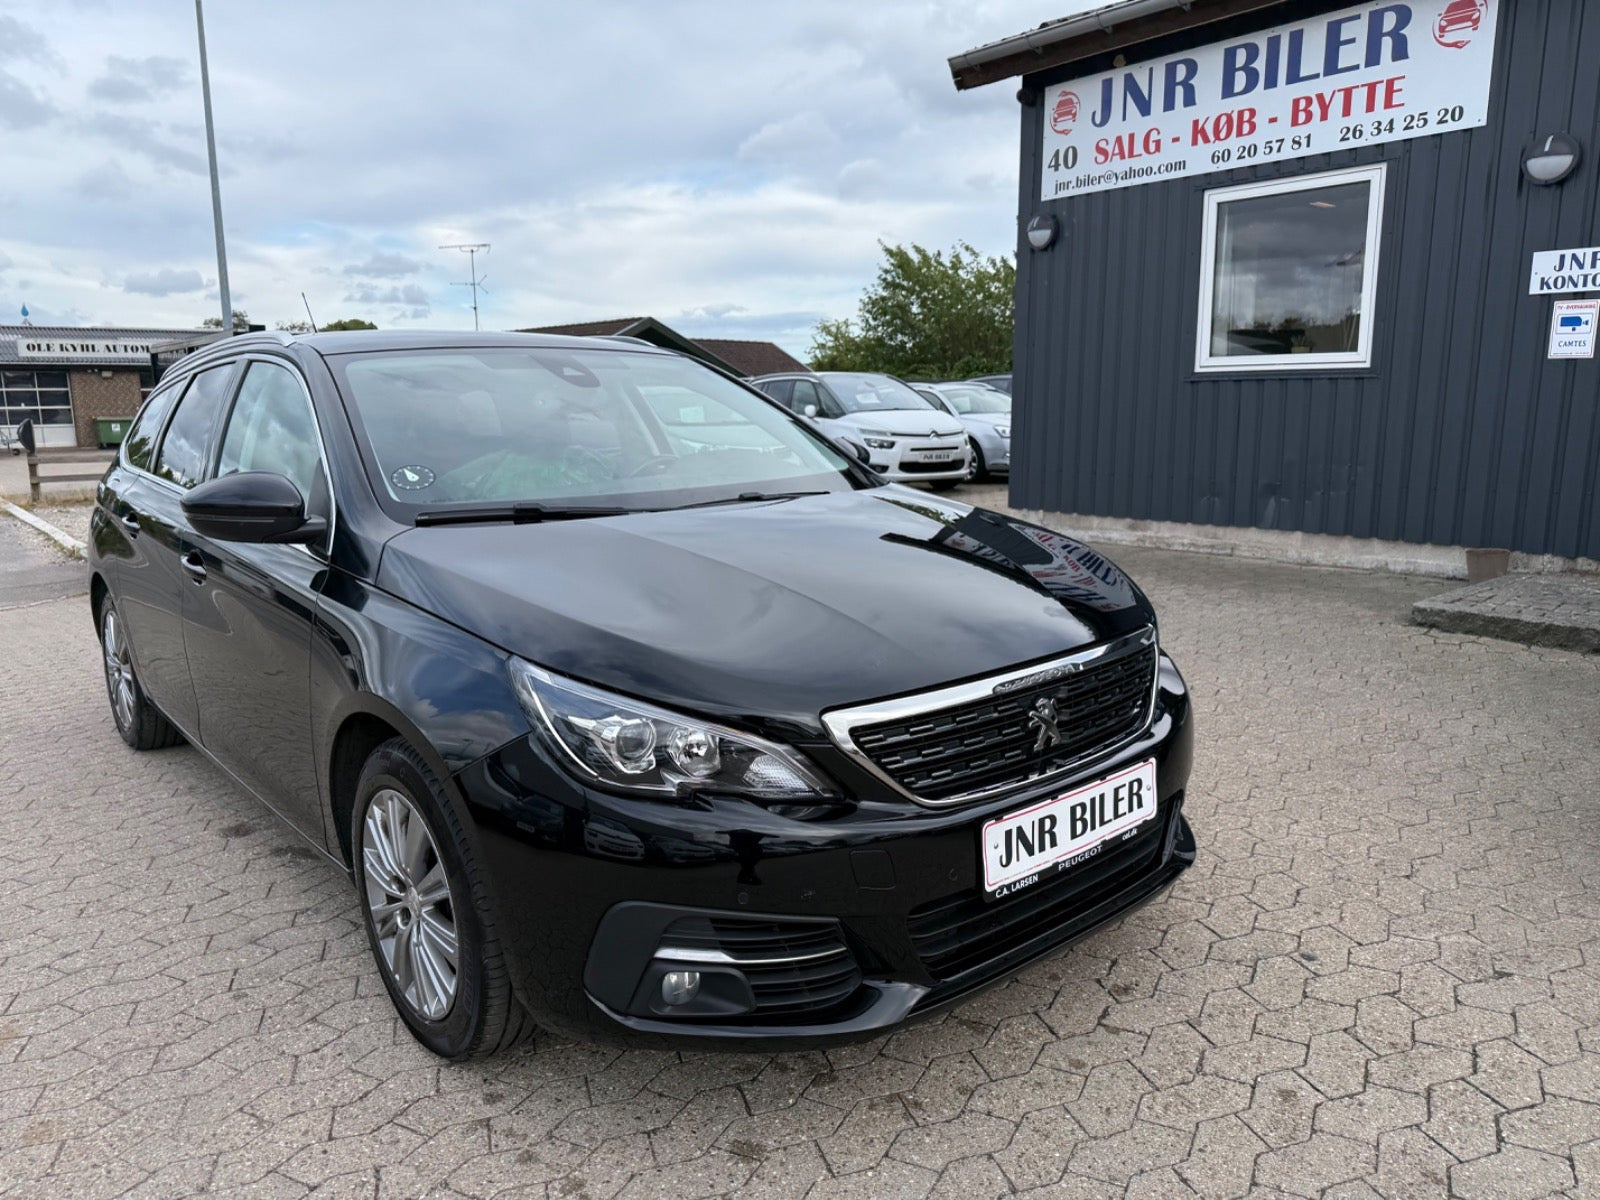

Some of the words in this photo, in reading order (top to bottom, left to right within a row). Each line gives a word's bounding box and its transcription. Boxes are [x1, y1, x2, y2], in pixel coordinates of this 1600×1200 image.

[1091, 59, 1198, 128] JNR
[1221, 4, 1413, 100] BILER
[1094, 127, 1162, 165] SALG
[1190, 107, 1257, 147] KØB
[1290, 75, 1406, 128] BYTTE
[1339, 124, 1363, 143] 26
[1370, 118, 1395, 137] 34
[1402, 111, 1429, 131] 25
[1436, 105, 1464, 125] 20
[1047, 145, 1079, 172] 40
[1210, 148, 1231, 165] 60
[1236, 143, 1258, 160] 20
[1263, 138, 1286, 155] 57
[1291, 133, 1312, 150] 81
[1054, 159, 1187, 195] jnr.biler@yahoo.com
[26, 342, 55, 353] OLE
[59, 343, 100, 354] KYHL
[103, 343, 150, 354] AUTOM
[999, 813, 1058, 868] JNR
[1069, 777, 1143, 841] BILER
[1058, 845, 1103, 871] PEUGEOT
[1011, 873, 1039, 892] LARSEN
